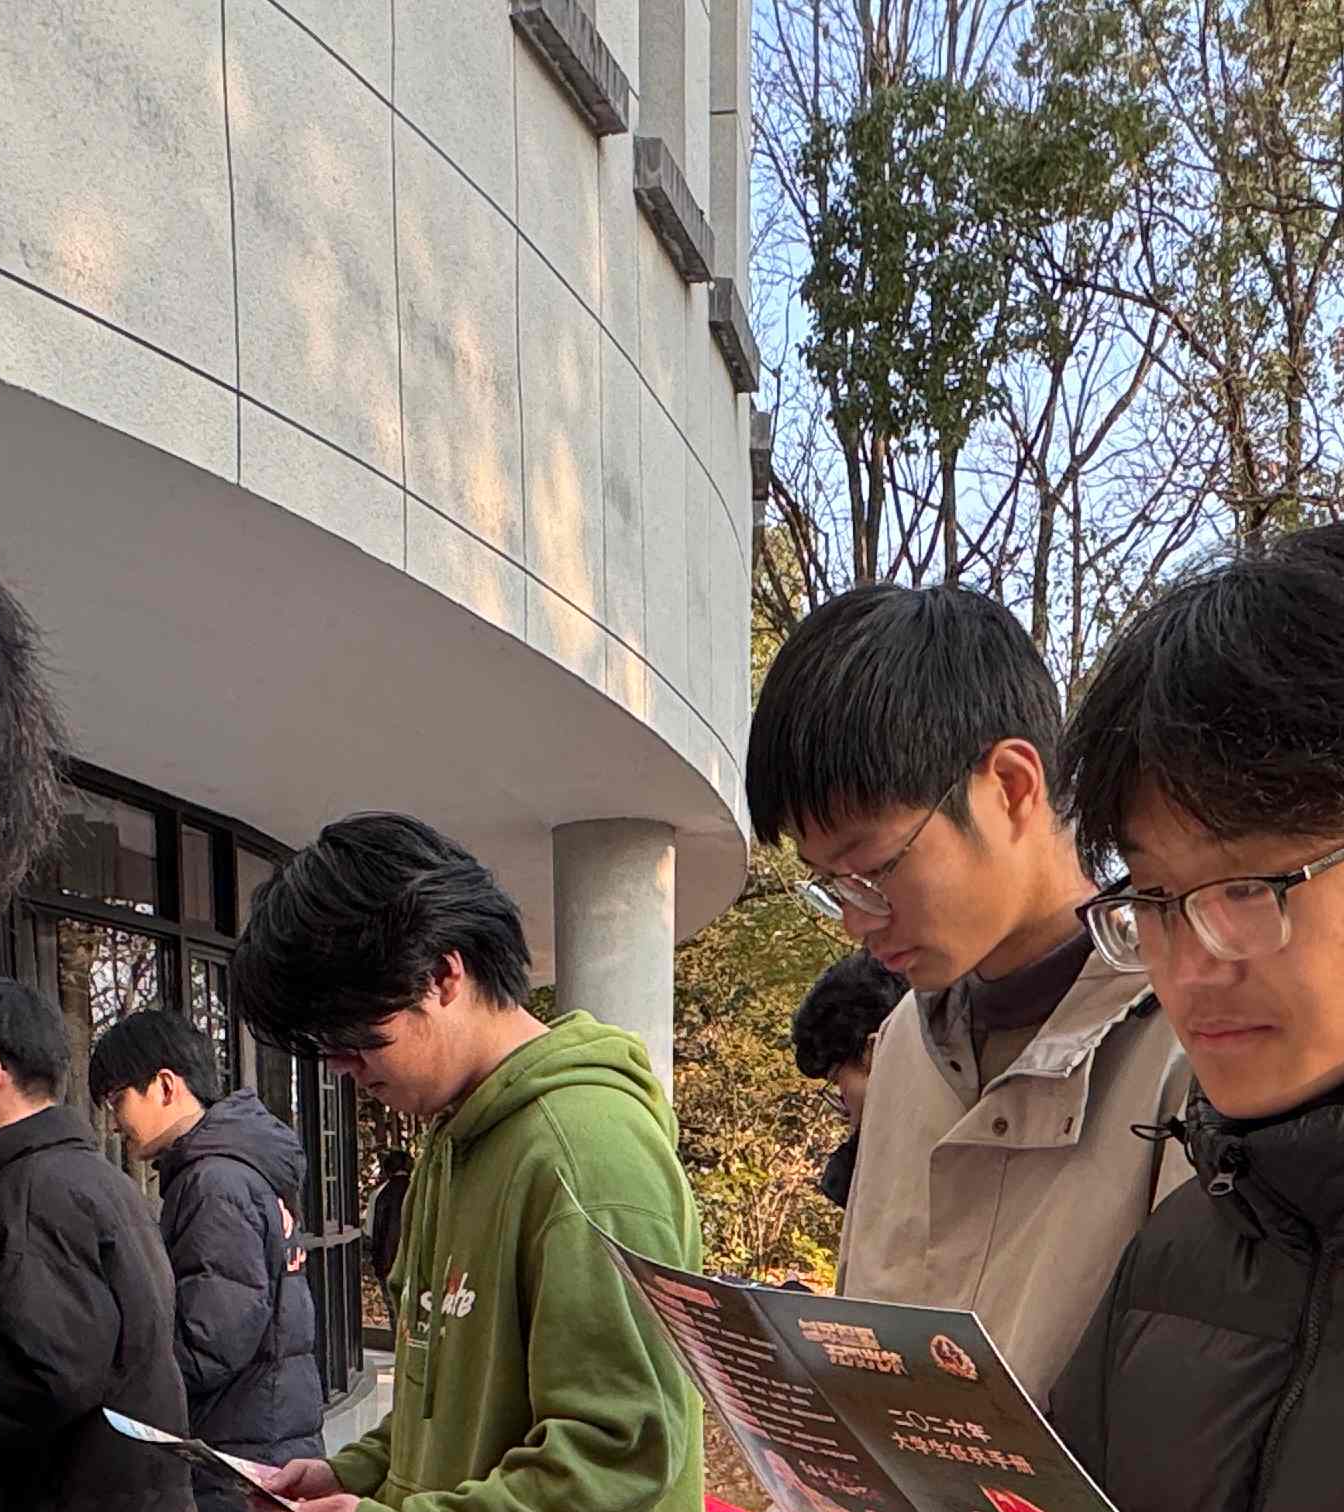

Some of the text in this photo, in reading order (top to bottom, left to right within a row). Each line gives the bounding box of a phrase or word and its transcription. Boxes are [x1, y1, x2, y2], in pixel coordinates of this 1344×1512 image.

[892, 1432, 1036, 1476] 大学生征兵手册
